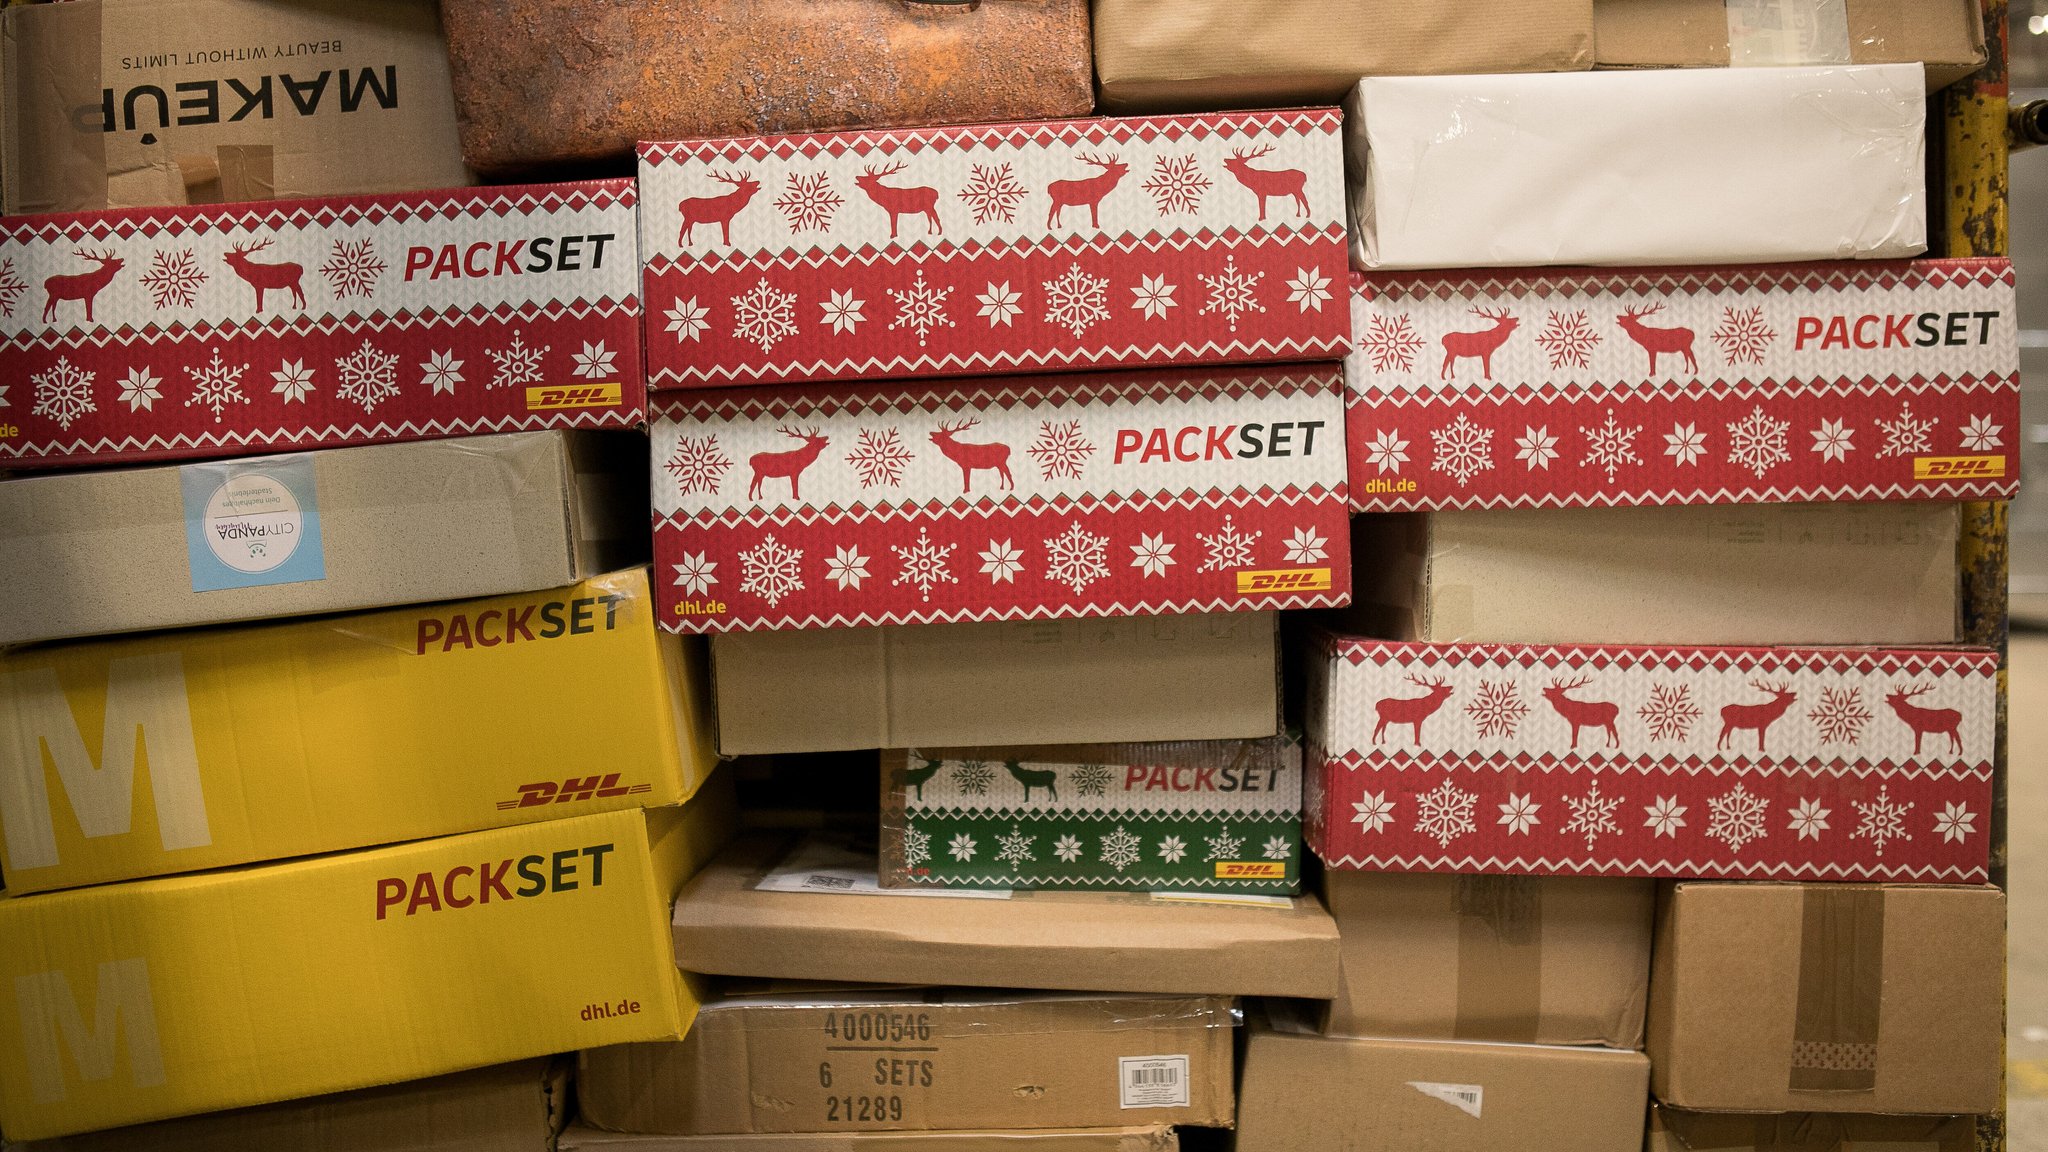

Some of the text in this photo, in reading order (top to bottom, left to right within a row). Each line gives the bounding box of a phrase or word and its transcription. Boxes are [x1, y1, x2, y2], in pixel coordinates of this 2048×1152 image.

[122, 40, 342, 70] BEAUTY WITHOUT LIMITS
[71, 65, 398, 139] MAKEUP
[404, 234, 615, 282] PACKSET
[1795, 311, 2000, 351] PACKSET
[538, 388, 609, 406] DHL
[1114, 421, 1325, 464] PACKSET
[1927, 460, 1994, 476] DHL
[1366, 478, 1417, 493] dhl.de
[1250, 573, 1319, 590] DHL
[674, 600, 727, 615] dhl.de
[417, 595, 624, 655] PACKSET
[0, 651, 212, 870] M
[518, 773, 631, 808] DHL
[1124, 764, 1282, 792] PACKSET
[376, 843, 614, 920] PACKSET
[1226, 865, 1275, 876] DHL
[581, 1000, 641, 1021] dhl.de
[15, 956, 167, 1104] M
[824, 1012, 930, 1042] 4000546
[819, 1058, 933, 1088] 6 SETS
[827, 1096, 902, 1121] 21289
